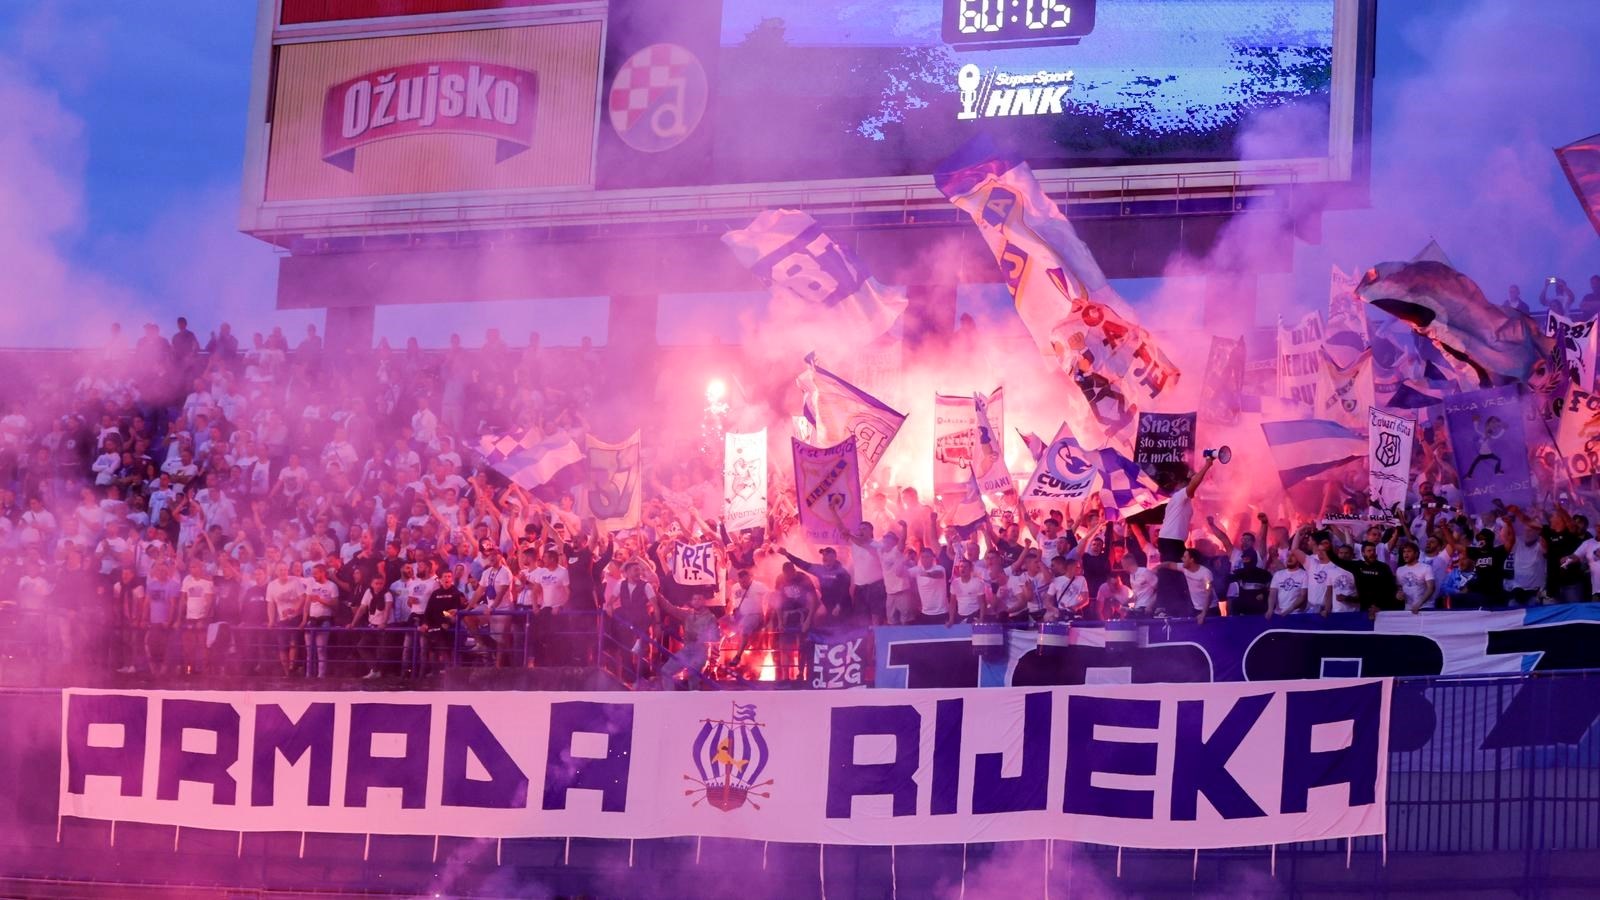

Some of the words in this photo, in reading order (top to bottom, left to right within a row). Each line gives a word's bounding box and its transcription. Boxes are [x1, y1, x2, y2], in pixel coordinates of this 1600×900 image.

[959, 0, 1071, 33] 60:05
[995, 70, 1074, 86] SuperSport
[342, 65, 519, 138] Ožujsko
[985, 86, 1070, 117] HNK
[1141, 415, 1190, 437] Snaga
[1140, 437, 1155, 448] što
[1157, 435, 1188, 449] svijetli
[1138, 450, 1148, 463] iz
[1150, 448, 1188, 463] mraka
[1037, 471, 1091, 491] ČUVAJ
[673, 541, 715, 578] FREE
[684, 569, 703, 580] I.T.
[813, 638, 863, 664] FCK
[66, 693, 634, 813] ARMADA
[825, 682, 1383, 821] RIJEKA
